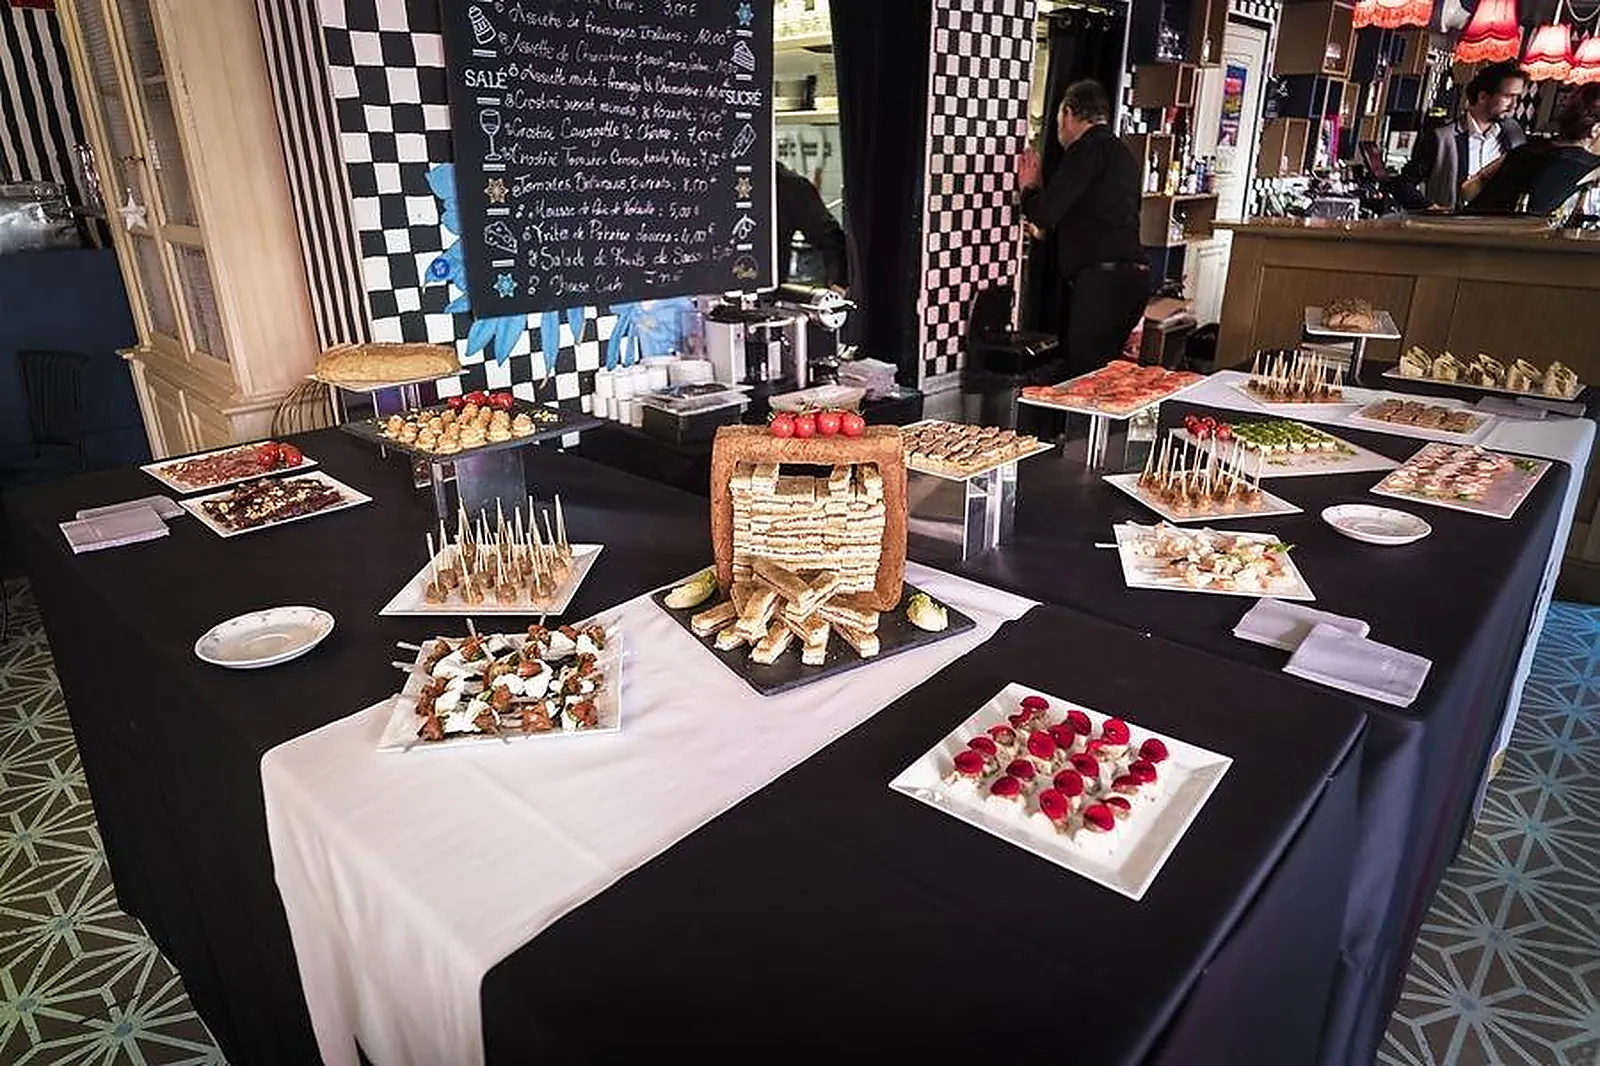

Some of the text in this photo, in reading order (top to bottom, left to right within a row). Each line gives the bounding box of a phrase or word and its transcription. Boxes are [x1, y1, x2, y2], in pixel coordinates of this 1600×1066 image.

[465, 68, 509, 90] SALÉ
[725, 88, 762, 107] SUCRÉ
[539, 246, 586, 272] Salade
